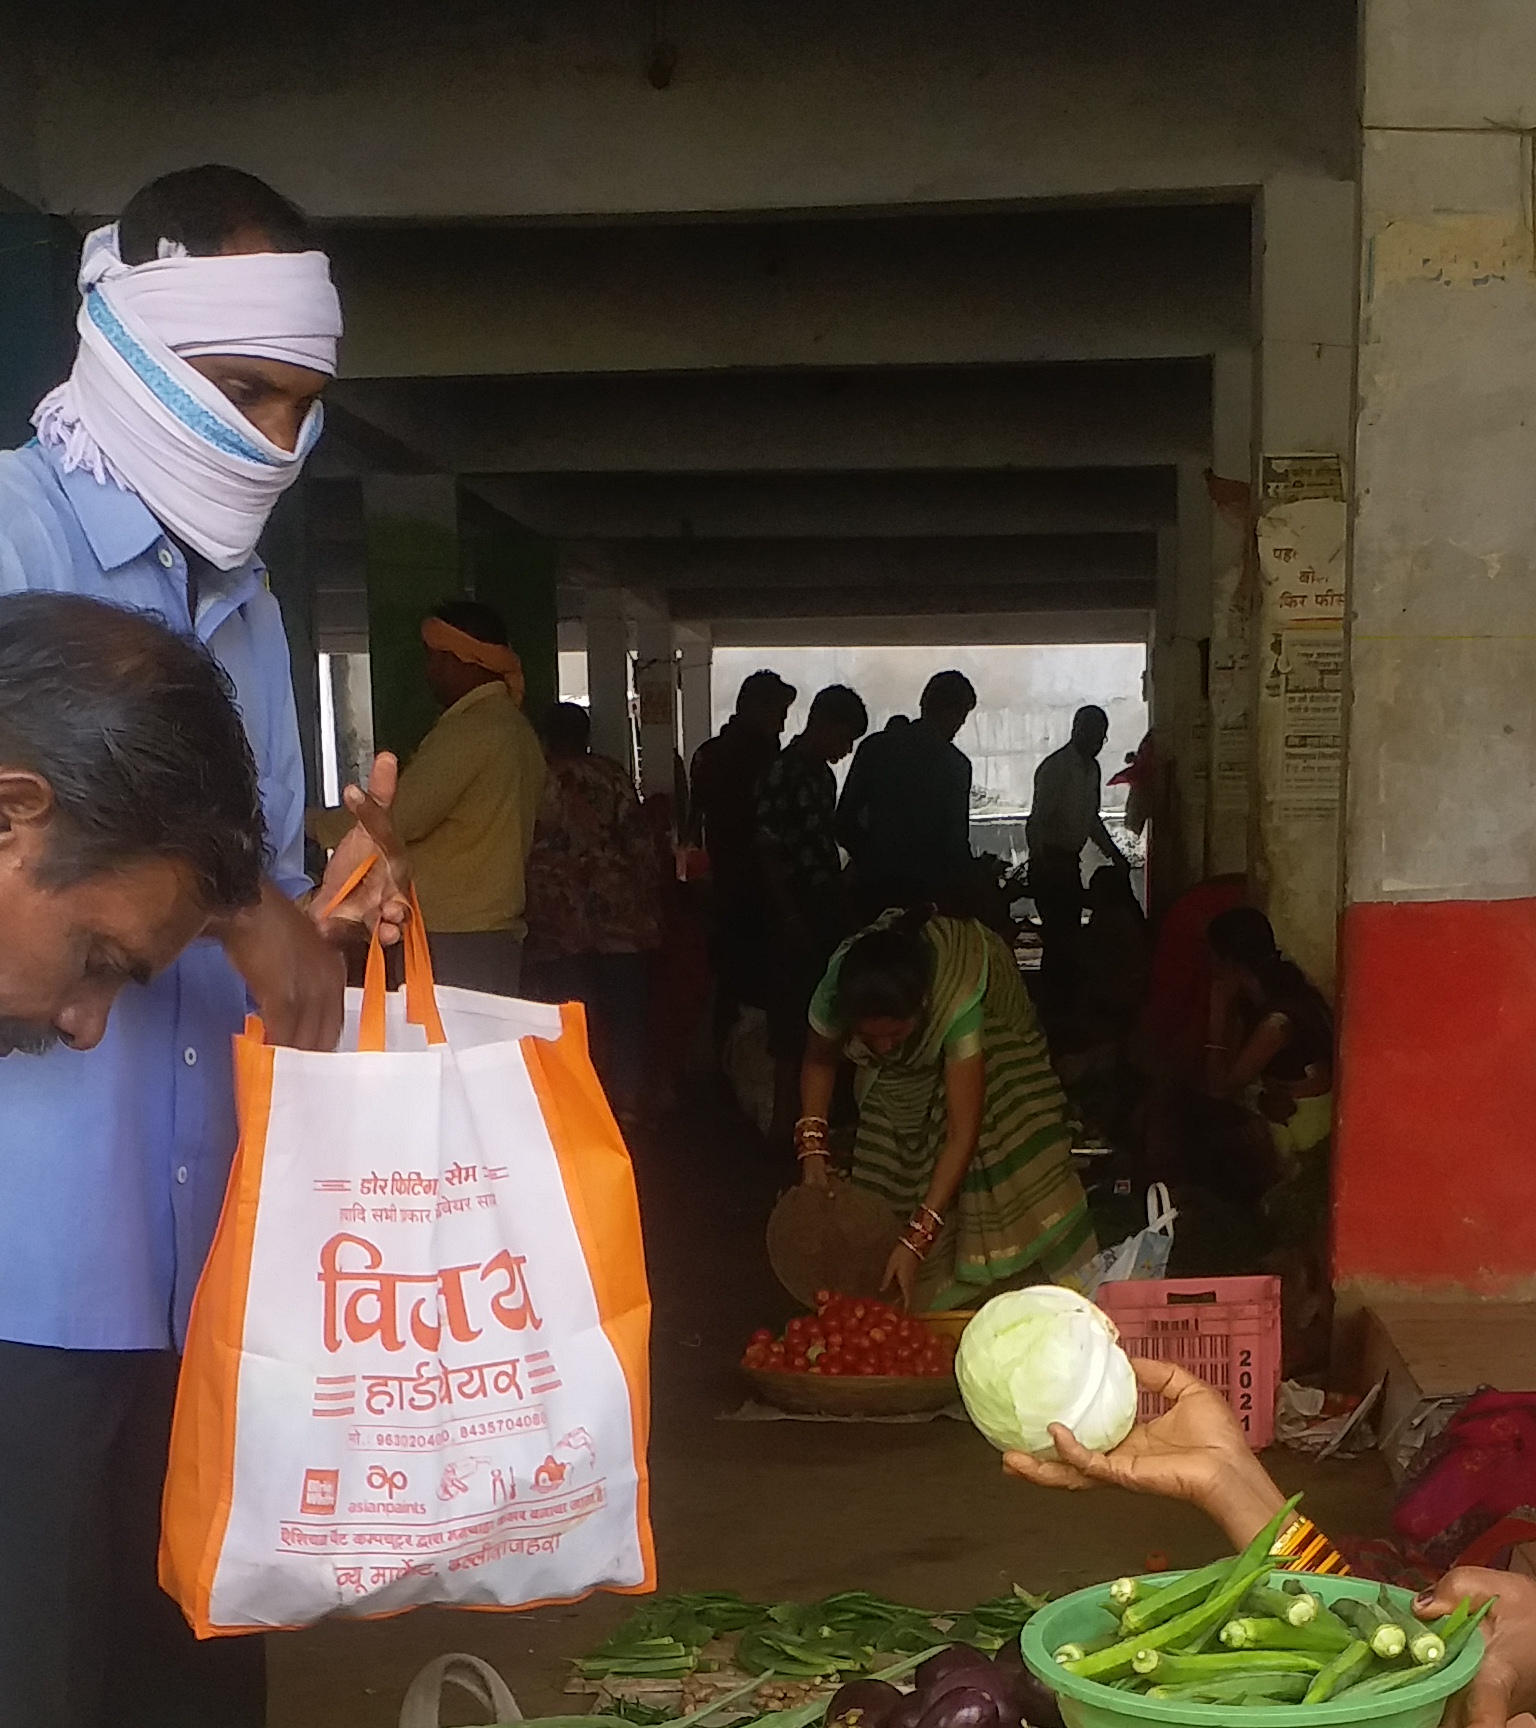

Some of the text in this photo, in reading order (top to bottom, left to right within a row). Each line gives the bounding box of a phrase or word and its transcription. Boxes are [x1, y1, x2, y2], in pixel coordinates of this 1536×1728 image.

[1273, 548, 1298, 563] पह
[360, 1171, 389, 1195] डोर
[317, 1232, 543, 1353] विजय
[1238, 1349, 1253, 1432] 2021
